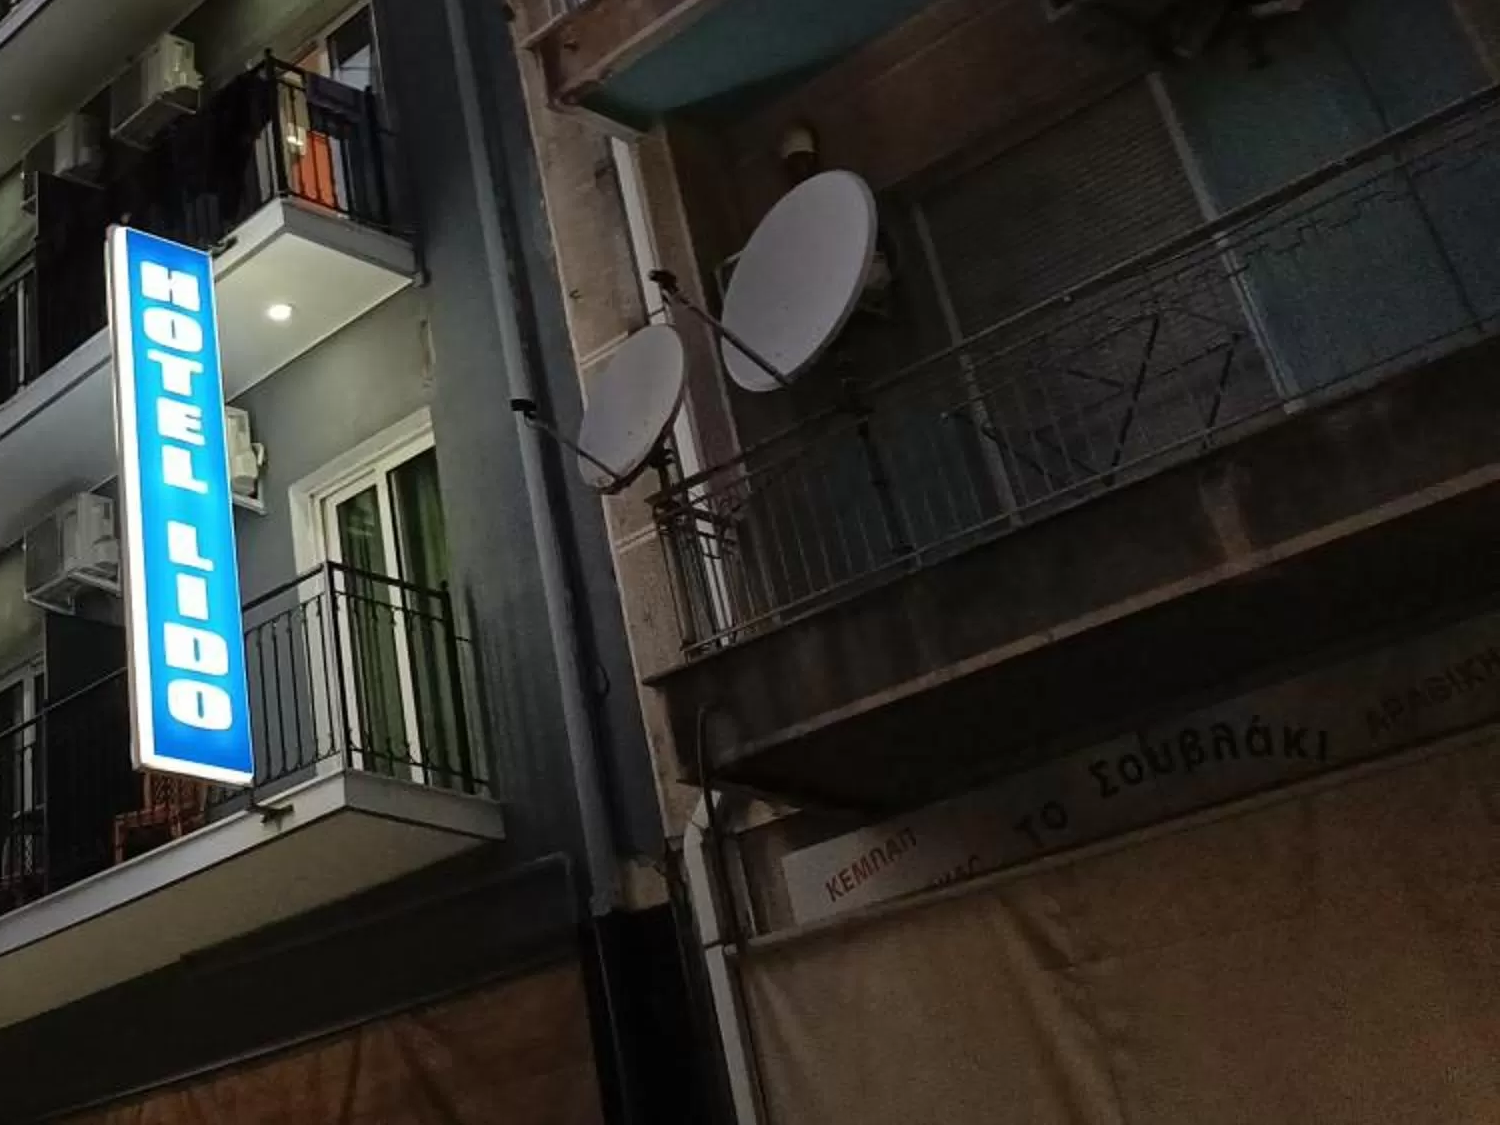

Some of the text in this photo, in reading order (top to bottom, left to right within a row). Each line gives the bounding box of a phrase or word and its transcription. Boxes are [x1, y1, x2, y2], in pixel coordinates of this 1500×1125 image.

[140, 261, 233, 731] HOTEL LIDO
[824, 827, 917, 903] ΚΕΜΠΑΠ
